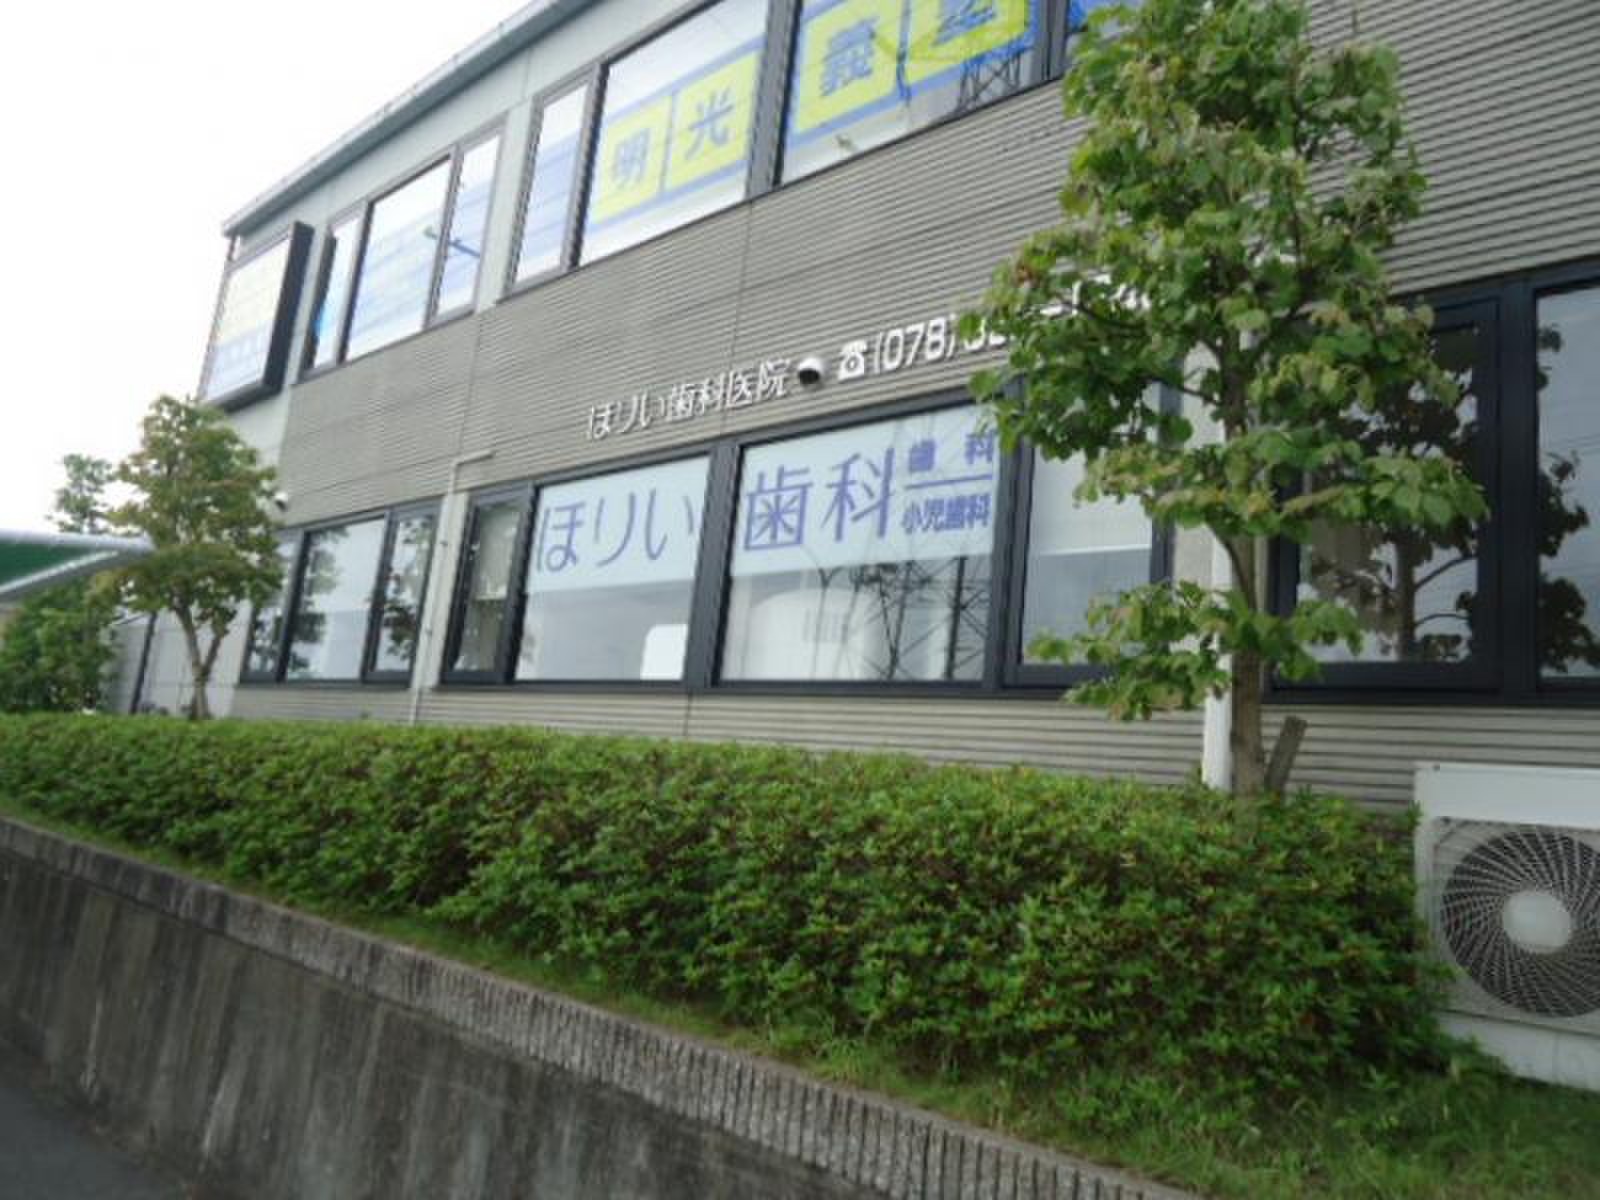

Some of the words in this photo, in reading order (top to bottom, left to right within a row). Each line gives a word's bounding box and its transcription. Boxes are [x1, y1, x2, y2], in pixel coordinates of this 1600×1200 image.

[586, 357, 791, 440] ほりい歯科医院
